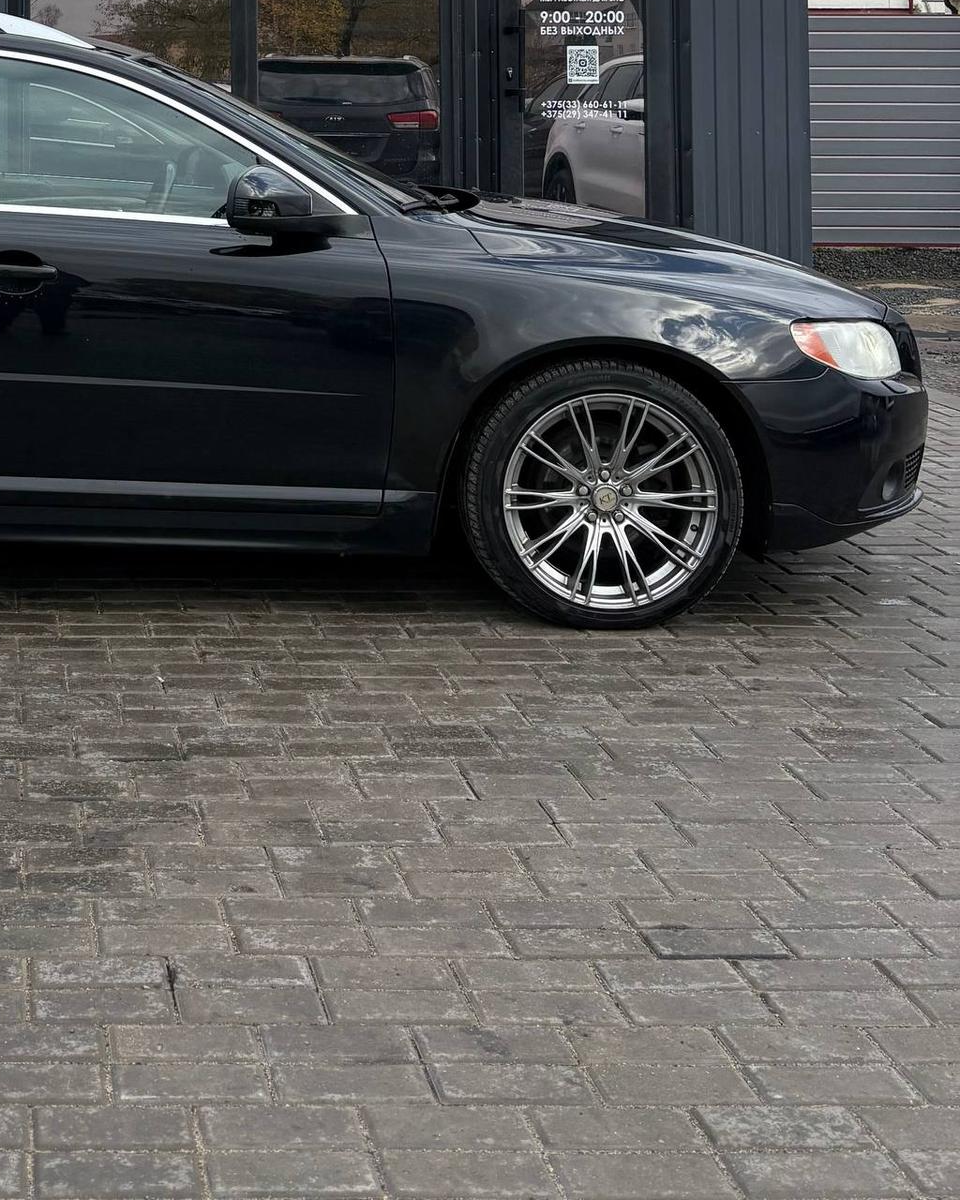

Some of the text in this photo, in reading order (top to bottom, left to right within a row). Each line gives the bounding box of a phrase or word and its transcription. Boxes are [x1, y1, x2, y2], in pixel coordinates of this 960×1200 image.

[540, 11, 571, 24] 9:00
[585, 11, 625, 24] 20:00
[540, 26, 625, 36] БЕЗ ВЫХОДНЫХ
[541, 100, 627, 110] +375(33) 660-61-11
[541, 110, 581, 120] +375(29)
